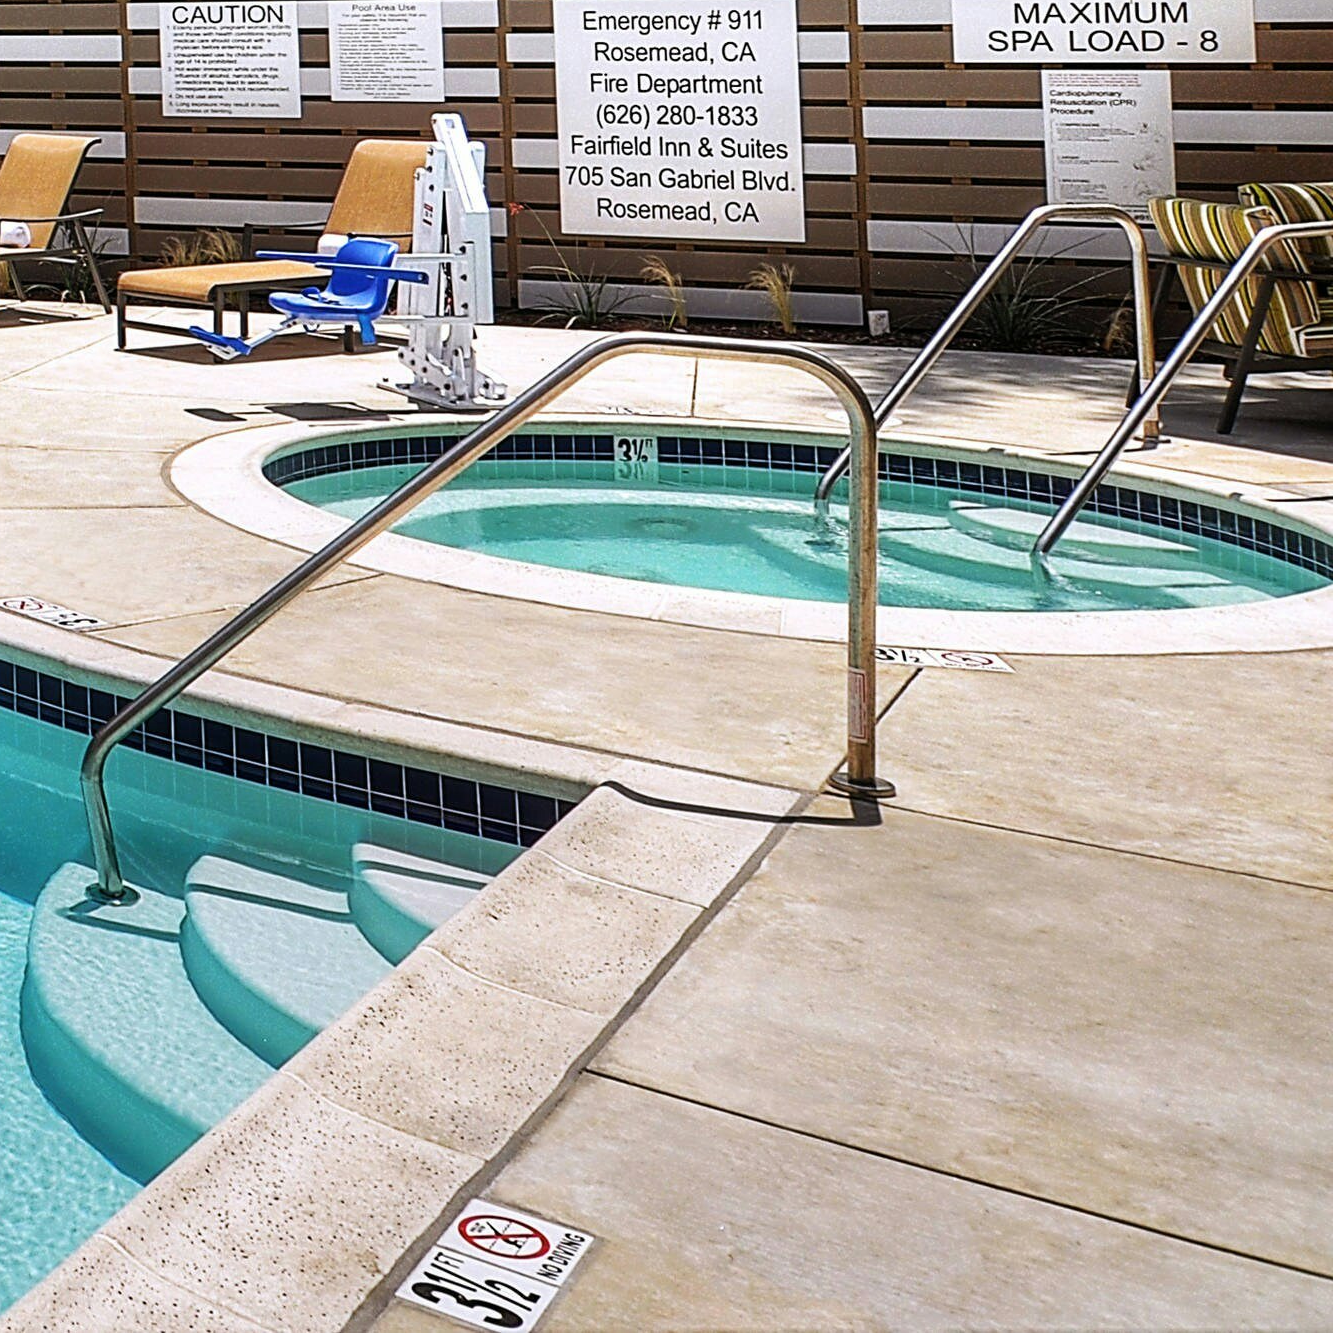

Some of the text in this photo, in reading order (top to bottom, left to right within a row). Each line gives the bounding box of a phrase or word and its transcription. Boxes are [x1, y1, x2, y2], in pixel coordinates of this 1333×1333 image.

[172, 5, 284, 24] CAUTION
[582, 9, 763, 35] Emergency # 911
[1014, 1, 1189, 24] MAXIMUM
[594, 41, 756, 65] Rosemead, CA
[988, 30, 1054, 52] SPA
[1069, 30, 1165, 52] LOAD
[1199, 30, 1219, 52] 8
[590, 73, 763, 98] Fire Department
[1049, 89, 1122, 98] Cardiopulmonary
[1109, 99, 1137, 107] (CPR)
[596, 104, 758, 129] (626) 280-1833
[571, 135, 788, 159] Fairfield Inn & Suites
[565, 166, 796, 191] 705 San Gabriel Blvd.
[597, 198, 759, 224] Rosemead, CA
[536, 1233, 585, 1281] NO DIVING
